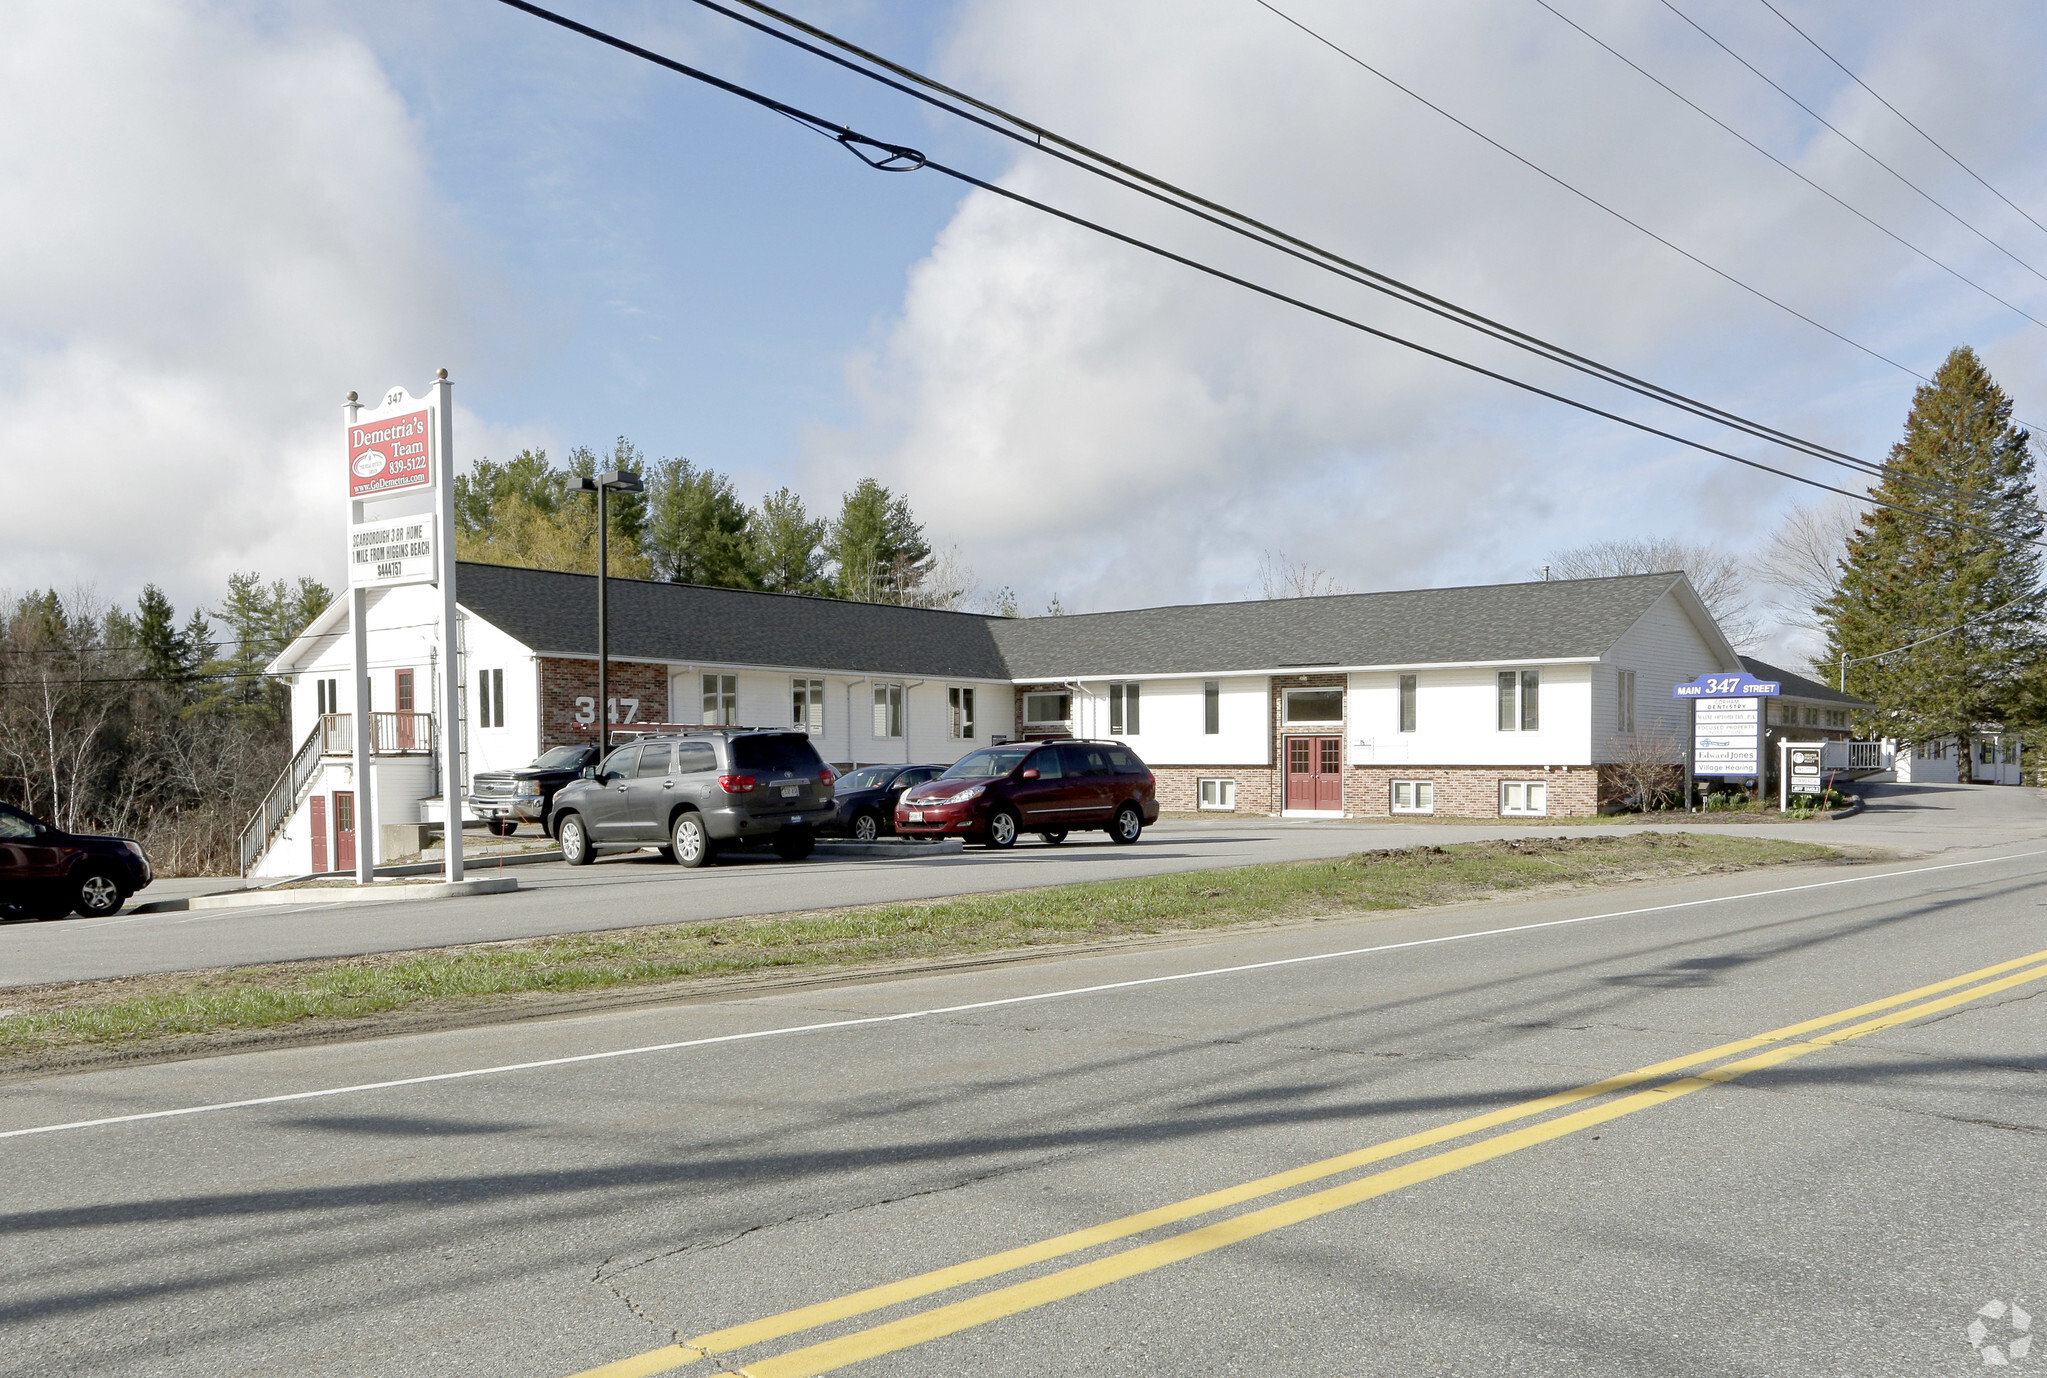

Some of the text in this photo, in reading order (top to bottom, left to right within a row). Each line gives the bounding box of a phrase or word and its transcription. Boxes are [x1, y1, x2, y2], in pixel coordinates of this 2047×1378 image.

[387, 391, 403, 406] 347
[352, 416, 424, 448] Demetria's
[391, 441, 424, 458] Team
[389, 455, 427, 475] 839-5122
[353, 473, 425, 493] www.GoDemetria.com
[352, 525, 422, 548] SCARBOROUGH 3 BR HOME
[356, 549, 369, 563] MILE
[370, 546, 385, 562] FROM
[386, 543, 409, 560] HIGGINS
[410, 541, 430, 557] BEACH
[1677, 678, 1776, 695] MAIN 347 STREET
[1699, 763, 1754, 773] Village Hearing
